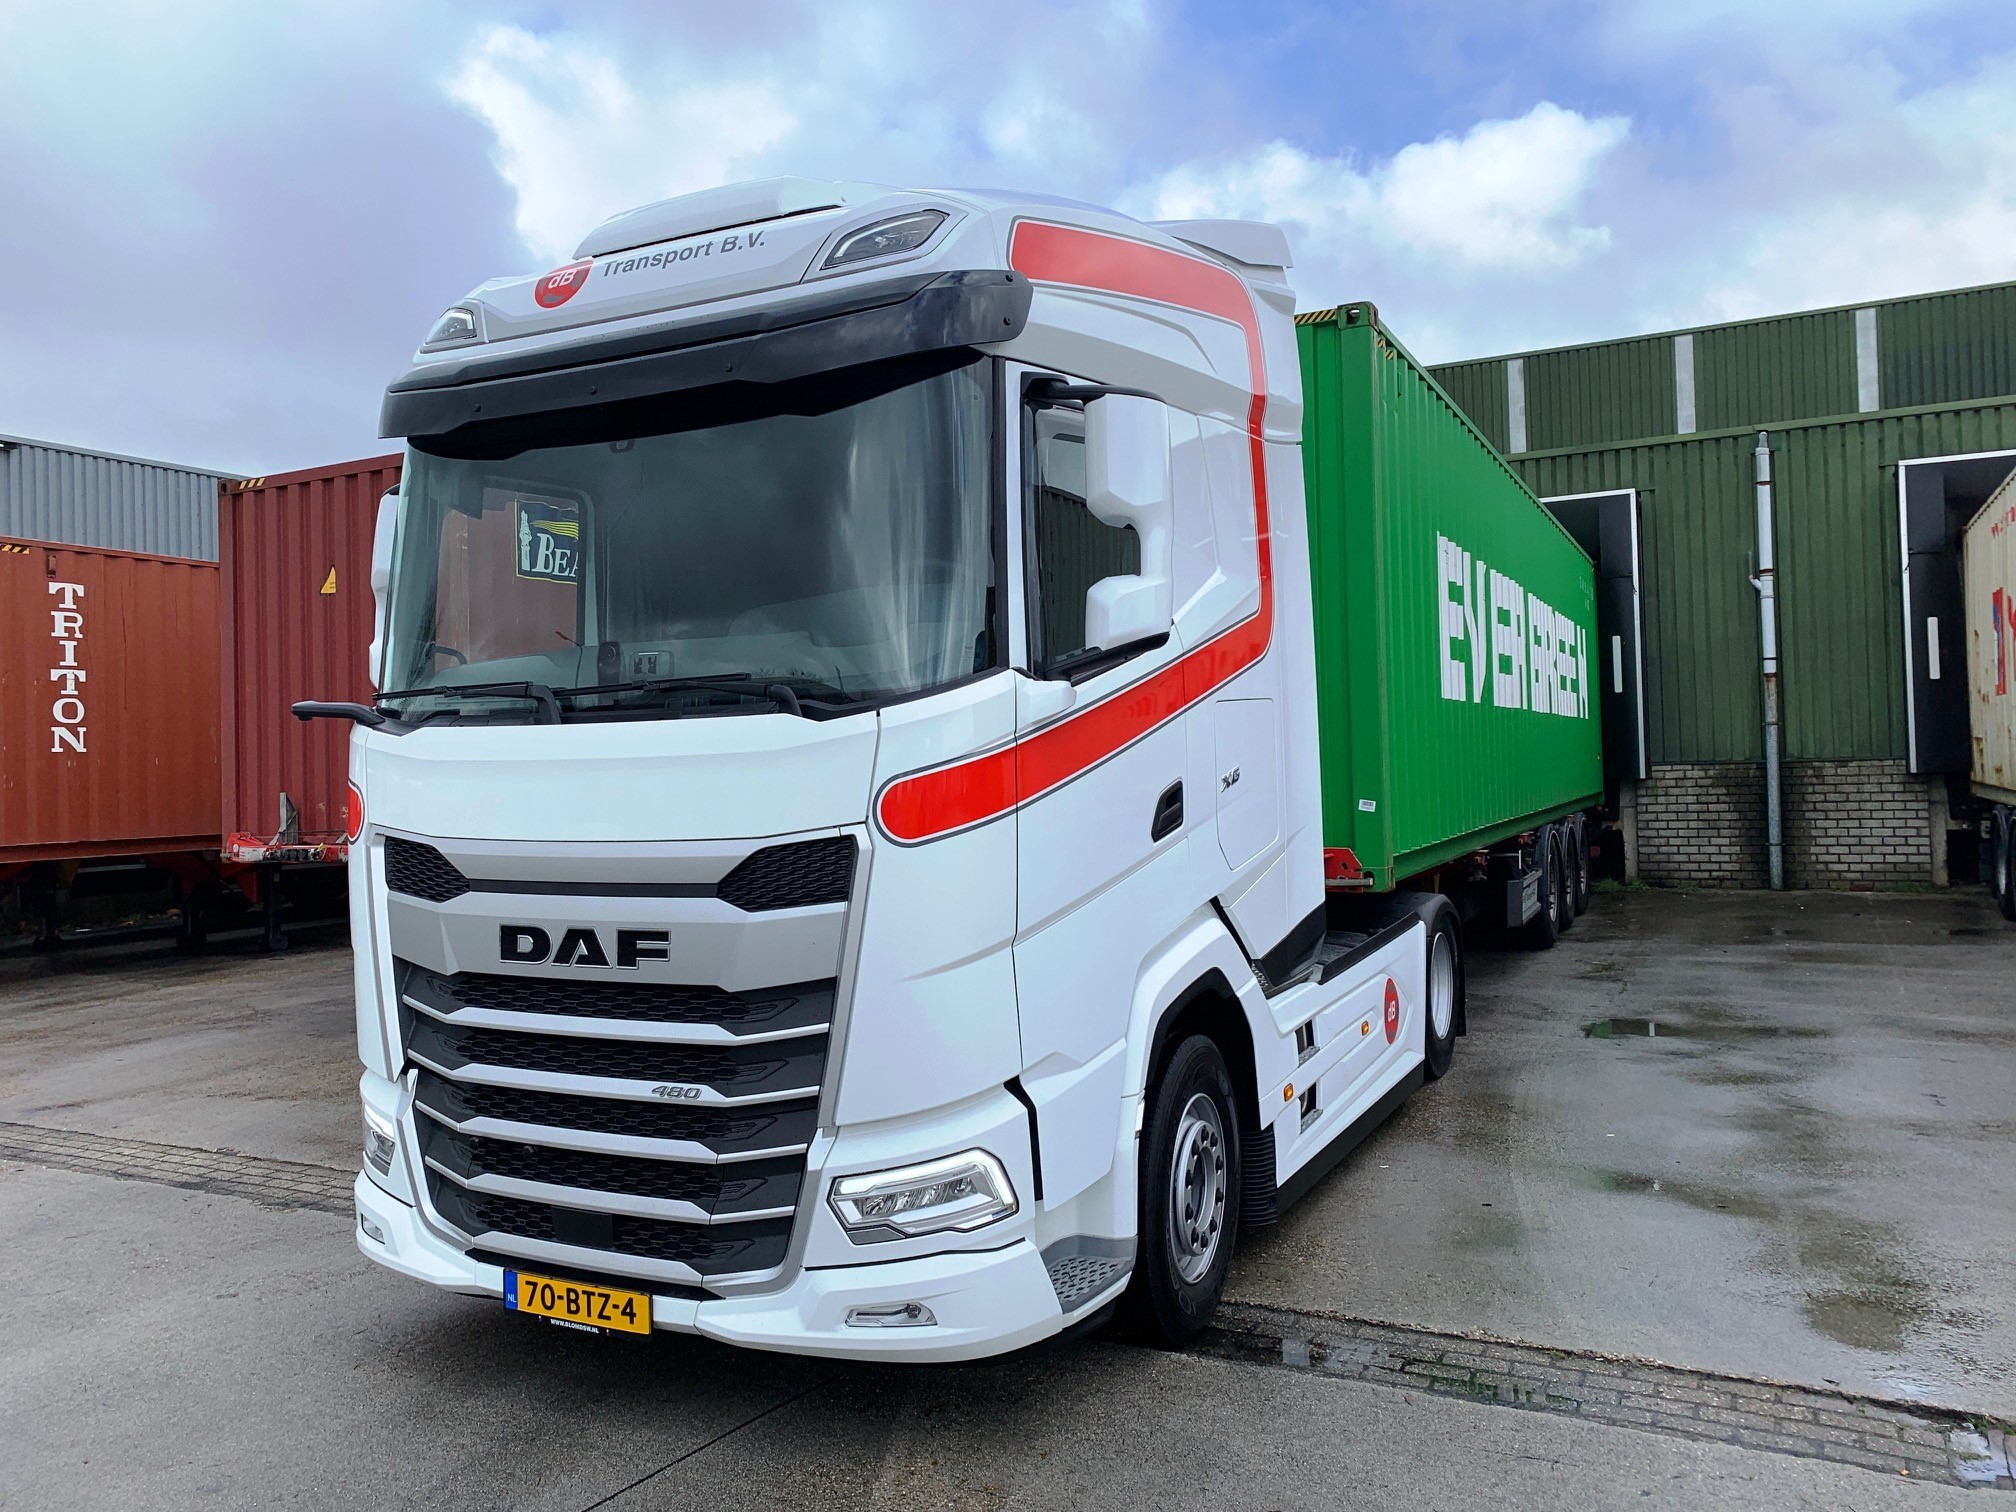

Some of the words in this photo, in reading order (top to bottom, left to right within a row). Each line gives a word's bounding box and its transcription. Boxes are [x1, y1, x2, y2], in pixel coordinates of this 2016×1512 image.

[548, 269, 575, 290] dB
[603, 241, 713, 277] Transport
[720, 230, 765, 253] B.V.
[1436, 530, 1589, 720] EVERGREEN
[48, 581, 87, 753] TRITON
[499, 923, 671, 970] DAF
[651, 1085, 702, 1100] 480
[507, 1293, 517, 1303] NL
[525, 1280, 637, 1325] 70-BTZ-4
